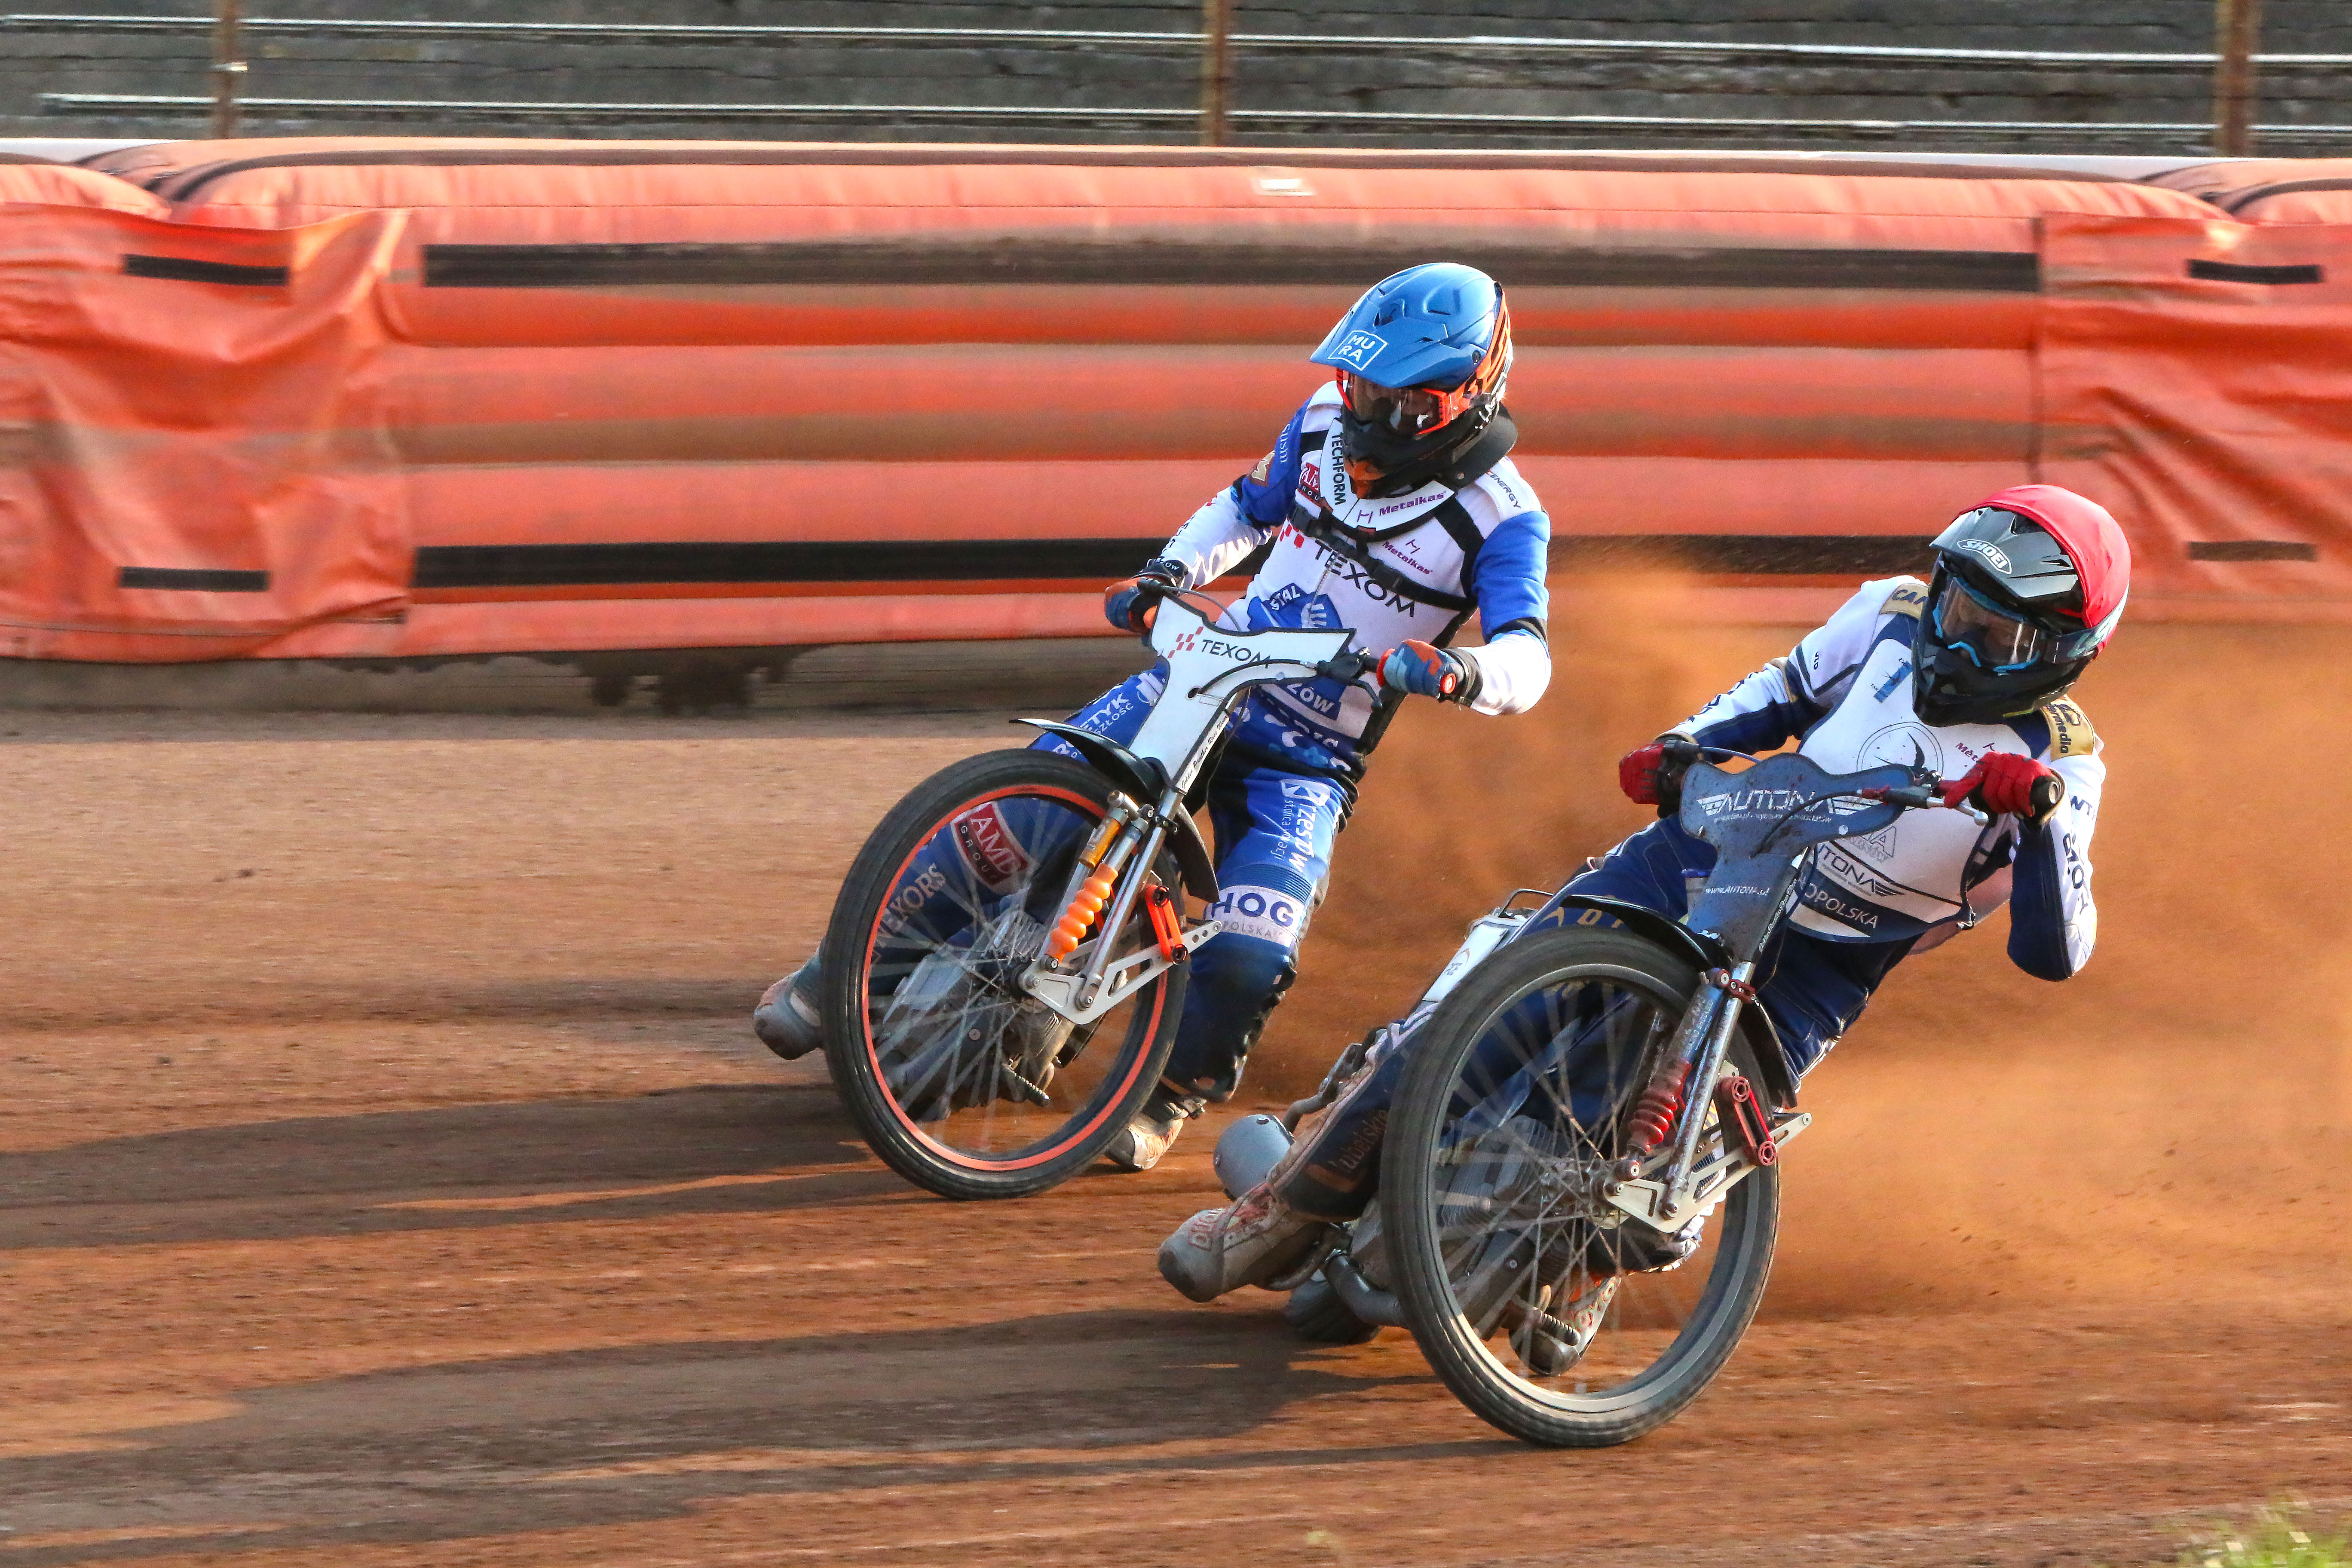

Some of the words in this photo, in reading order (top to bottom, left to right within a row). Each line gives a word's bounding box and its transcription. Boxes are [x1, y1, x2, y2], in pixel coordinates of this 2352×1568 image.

[1337, 345, 1363, 362] RA
[1348, 334, 1376, 349] MU
[1331, 432, 1346, 505] TECHFORM
[1379, 493, 1445, 516] Metalkas
[1488, 472, 1522, 508] ENERGY
[1382, 541, 1432, 575] Metalkas
[1962, 540, 2008, 569] SHOEI
[1314, 539, 1415, 618] TEXOM
[1269, 585, 1301, 611] STAL
[1201, 639, 1271, 669] TEXOM
